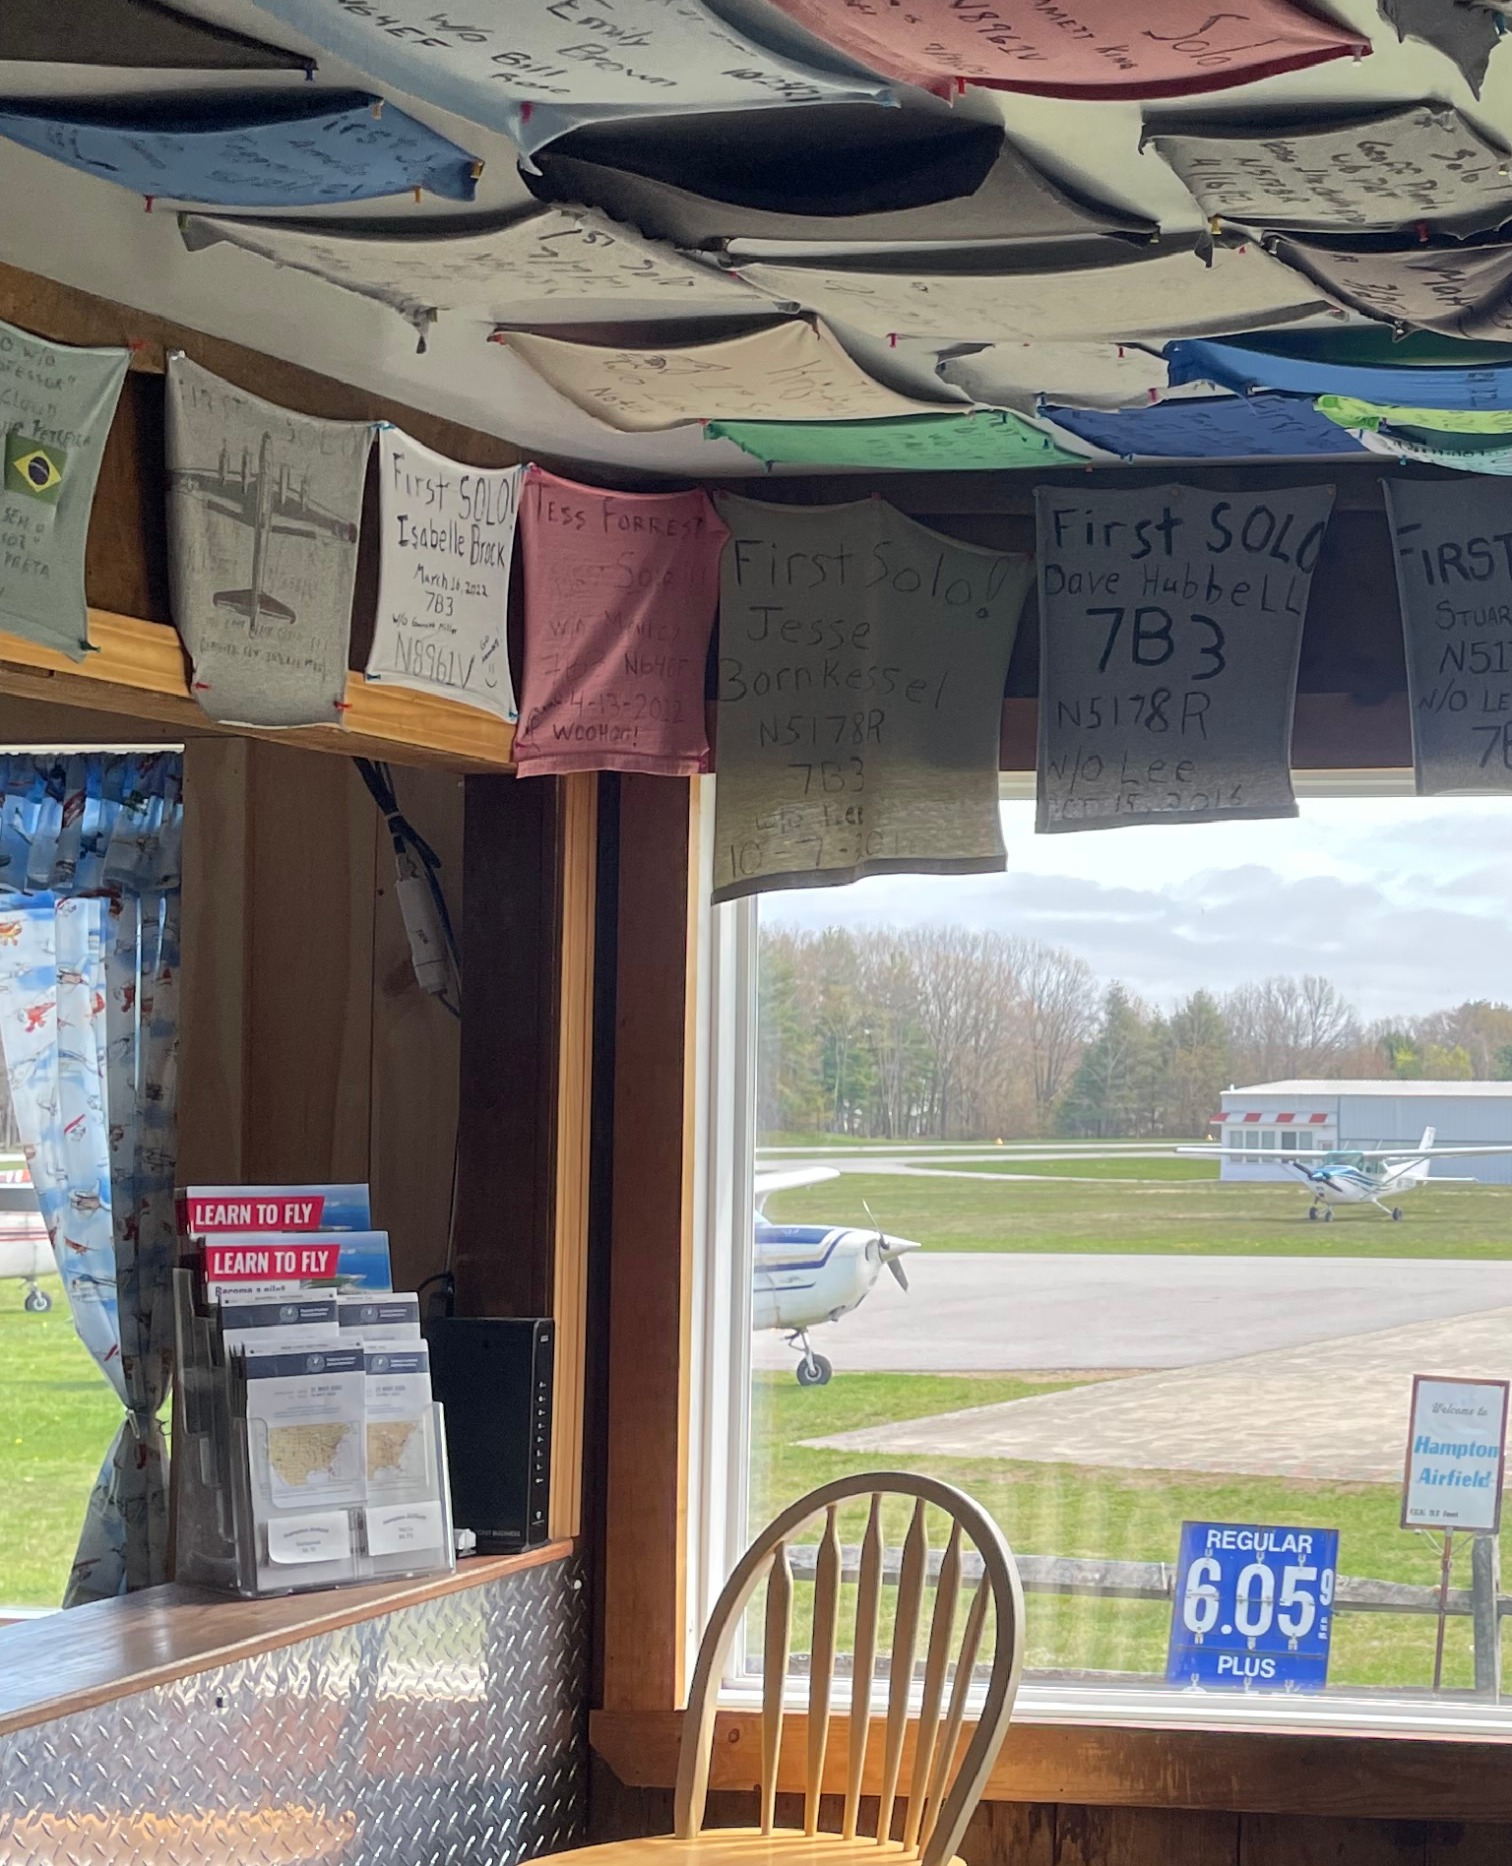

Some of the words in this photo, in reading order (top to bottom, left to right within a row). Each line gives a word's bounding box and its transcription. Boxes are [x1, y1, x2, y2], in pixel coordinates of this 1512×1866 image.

[393, 451, 451, 513] First
[396, 513, 465, 557] Isabelle
[1052, 506, 1184, 561] First
[734, 540, 855, 589] First
[1044, 562, 1121, 598] Dave
[423, 590, 455, 617] 7B3
[746, 605, 872, 651] Jesse
[1085, 605, 1227, 681] 7B3
[393, 629, 476, 690] N8961V
[759, 708, 887, 749] N5178R
[1057, 687, 1212, 740] N5178R
[194, 1203, 252, 1227] LEARN
[255, 1202, 279, 1224] TO
[283, 1201, 314, 1225] FLY
[213, 1251, 270, 1275] LEARN
[272, 1250, 297, 1273] TO
[300, 1249, 330, 1272] FLY
[1431, 1401, 1474, 1417] Welcome
[1475, 1405, 1489, 1418] to
[1414, 1435, 1500, 1461] Hampton
[1418, 1466, 1490, 1490] Airfield
[1206, 1529, 1313, 1554] REGULAR
[1183, 1557, 1317, 1638] 6.05
[1217, 1655, 1277, 1679] PLUS
